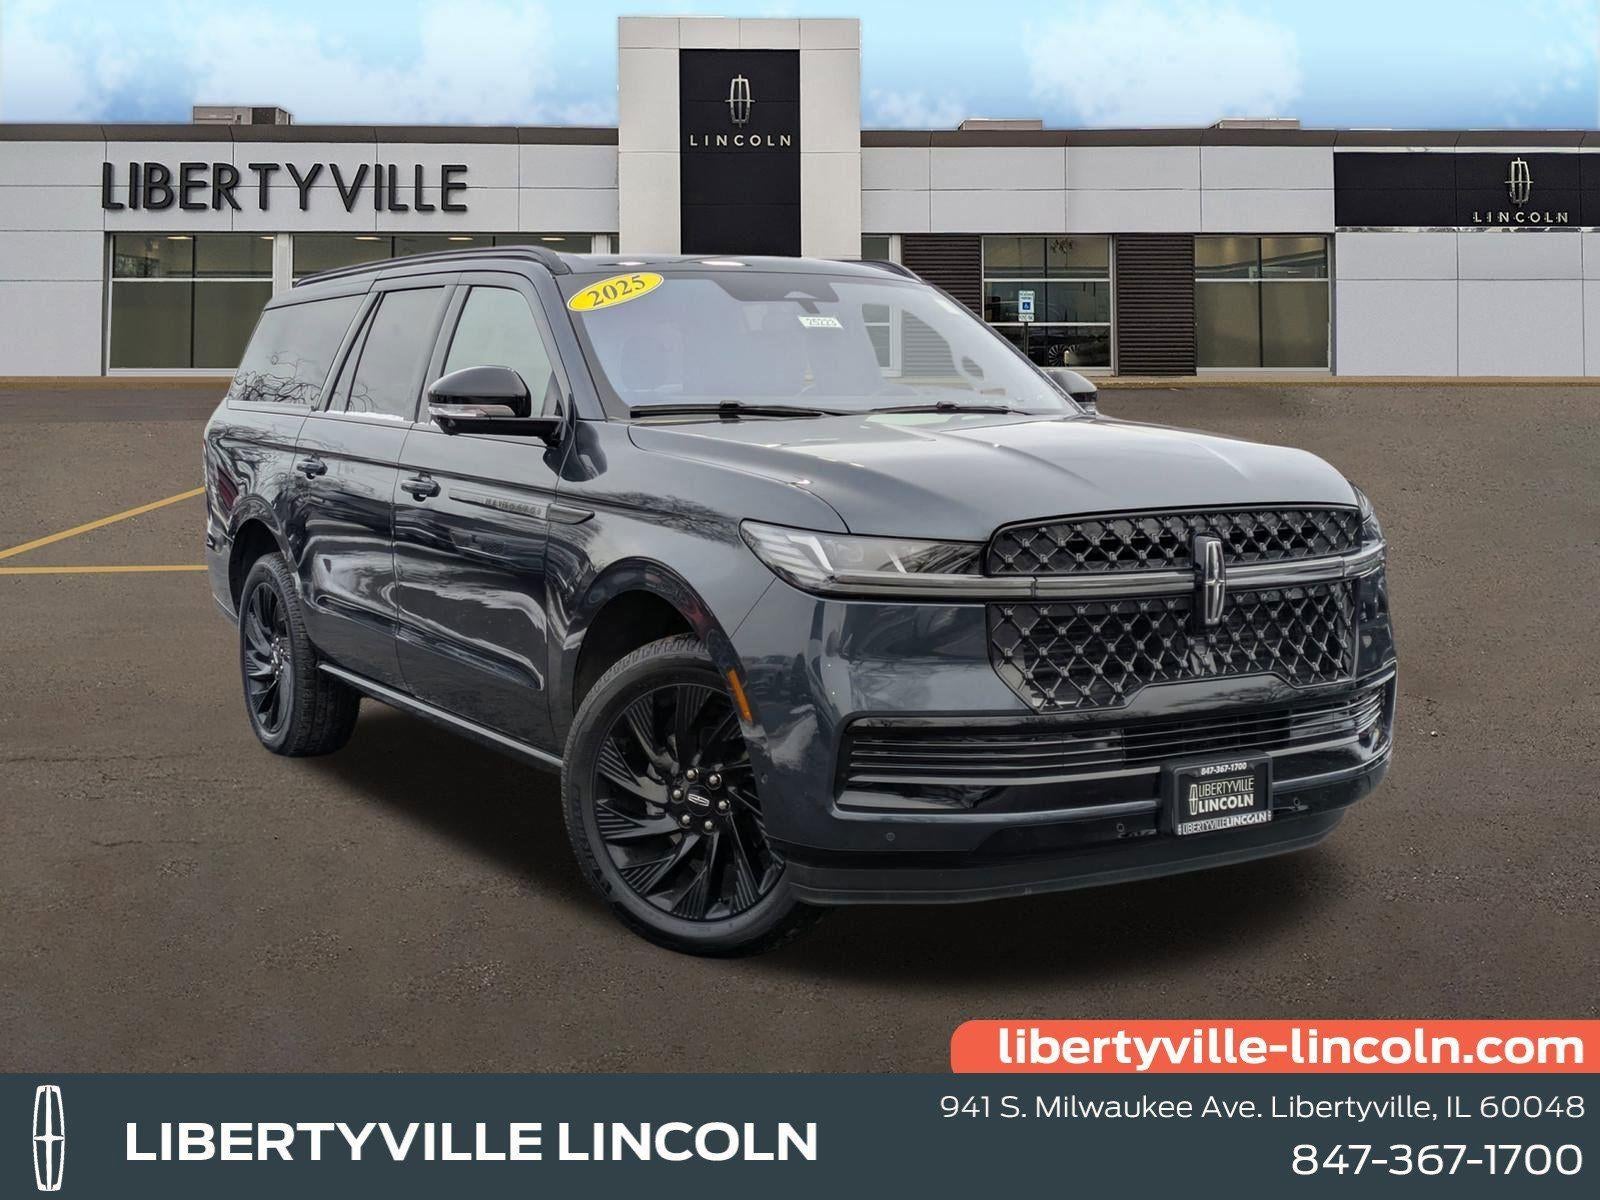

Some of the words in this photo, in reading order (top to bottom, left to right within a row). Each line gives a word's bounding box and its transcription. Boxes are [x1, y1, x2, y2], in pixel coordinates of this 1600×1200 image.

[690, 134, 791, 146] LINCOLN
[102, 162, 468, 212] LIBERTYVILLE
[1473, 211, 1568, 223] LINCOLN
[587, 274, 646, 307] 2025
[1201, 762, 1247, 775] 847-367-1700
[1199, 778, 1254, 797] LIBERTYVILLE
[1199, 794, 1254, 813] LINCOLN
